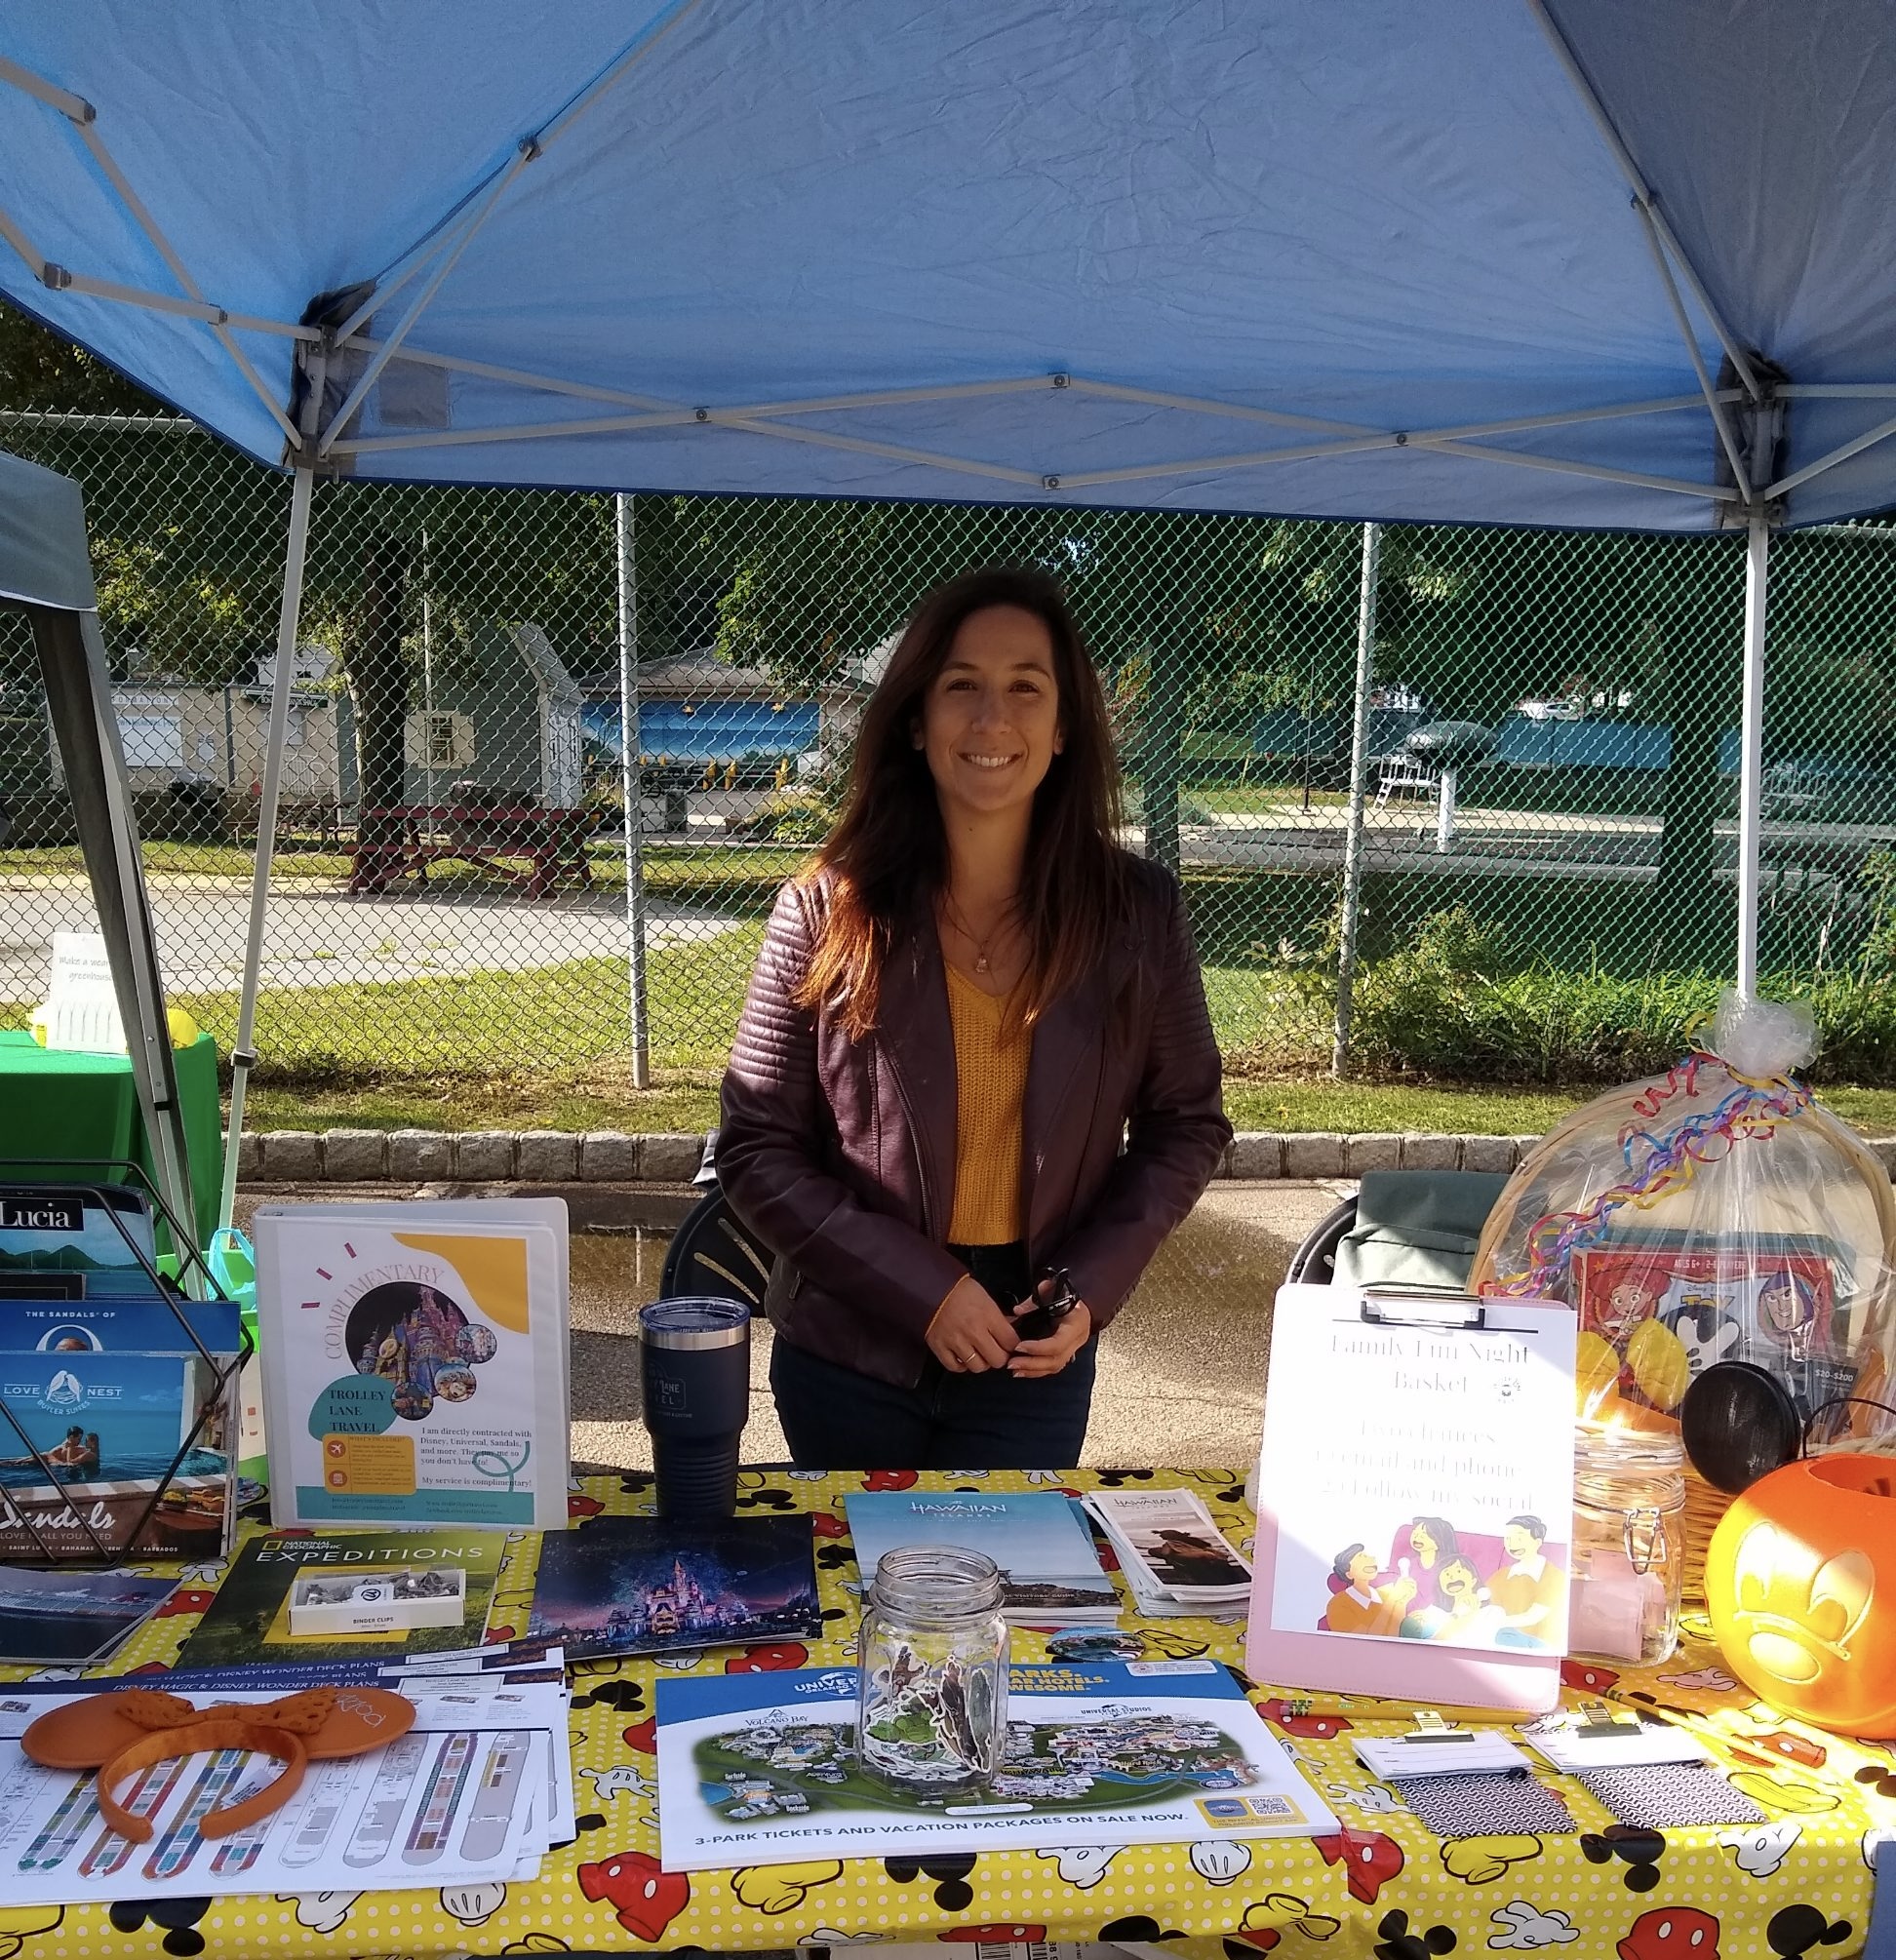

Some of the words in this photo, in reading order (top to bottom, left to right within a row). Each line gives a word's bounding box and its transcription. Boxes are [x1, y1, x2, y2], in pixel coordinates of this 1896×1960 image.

[90, 959, 108, 967] wear
[0, 1200, 72, 1228] Lucia
[87, 1388, 123, 1396] NEST
[328, 1390, 386, 1401] TROLLEY
[329, 1405, 363, 1416] LANE
[330, 1422, 380, 1432] TRAVEL
[441, 1428, 469, 1437] directly
[909, 1502, 1007, 1514] HAWAIIAN
[0, 1532, 25, 1541] LOVE
[60, 1532, 83, 1541] YOU
[255, 1547, 484, 1562] EXPEDITIONS
[1008, 1668, 1082, 1678] ARKS.
[793, 1676, 857, 1693] UNIVER
[745, 1717, 789, 1726] VOLCANO
[694, 1831, 758, 1846] 3-PARK
[762, 1827, 833, 1840] TICKETS
[837, 1825, 877, 1836] AND
[880, 1822, 968, 1834] VACATION
[973, 1816, 1062, 1829] PACKAGES
[1066, 1814, 1093, 1823] ON
[1097, 1814, 1138, 1823] SALE
